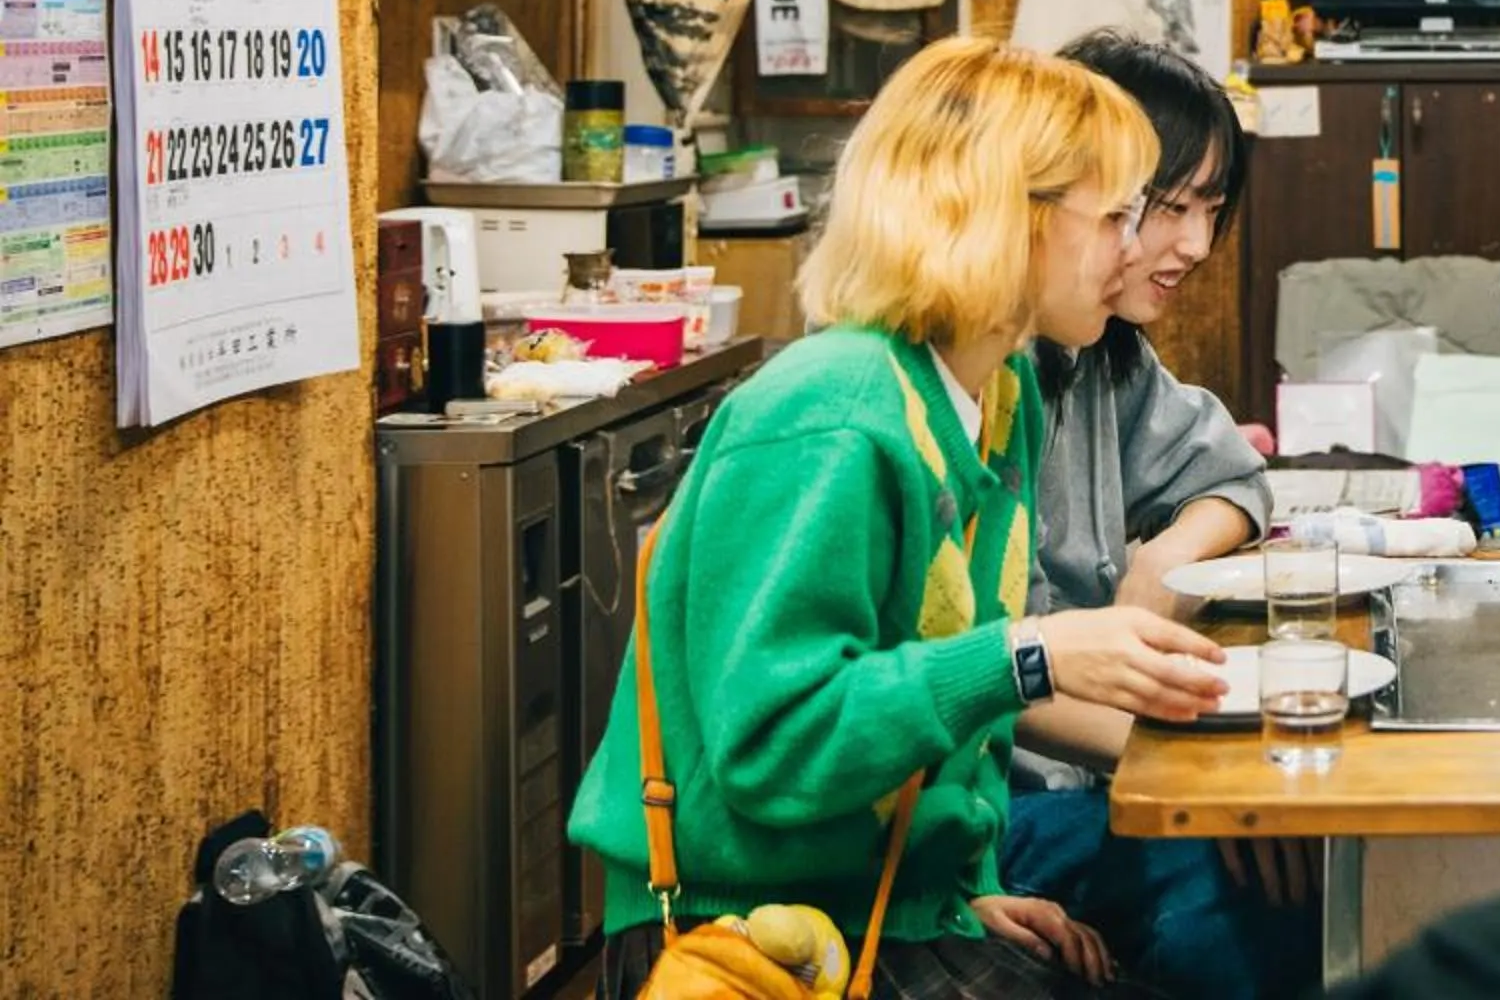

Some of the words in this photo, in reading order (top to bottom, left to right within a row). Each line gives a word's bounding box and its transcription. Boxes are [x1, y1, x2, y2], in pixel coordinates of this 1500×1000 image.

[142, 31, 160, 82] 14
[164, 30, 185, 82] 15
[191, 30, 212, 81] 16
[218, 30, 238, 80] 17
[244, 29, 264, 80] 18
[270, 29, 292, 78] 19
[297, 29, 326, 77] 20
[147, 130, 163, 185] 21
[167, 127, 188, 181] 22
[191, 125, 214, 178] 23
[217, 124, 239, 175] 24
[243, 122, 266, 172] 25
[270, 120, 295, 169] 26
[300, 118, 329, 166] 27
[148, 230, 168, 286] 28
[170, 226, 190, 281] 29
[193, 221, 215, 276] 30
[252, 238, 260, 264] 2
